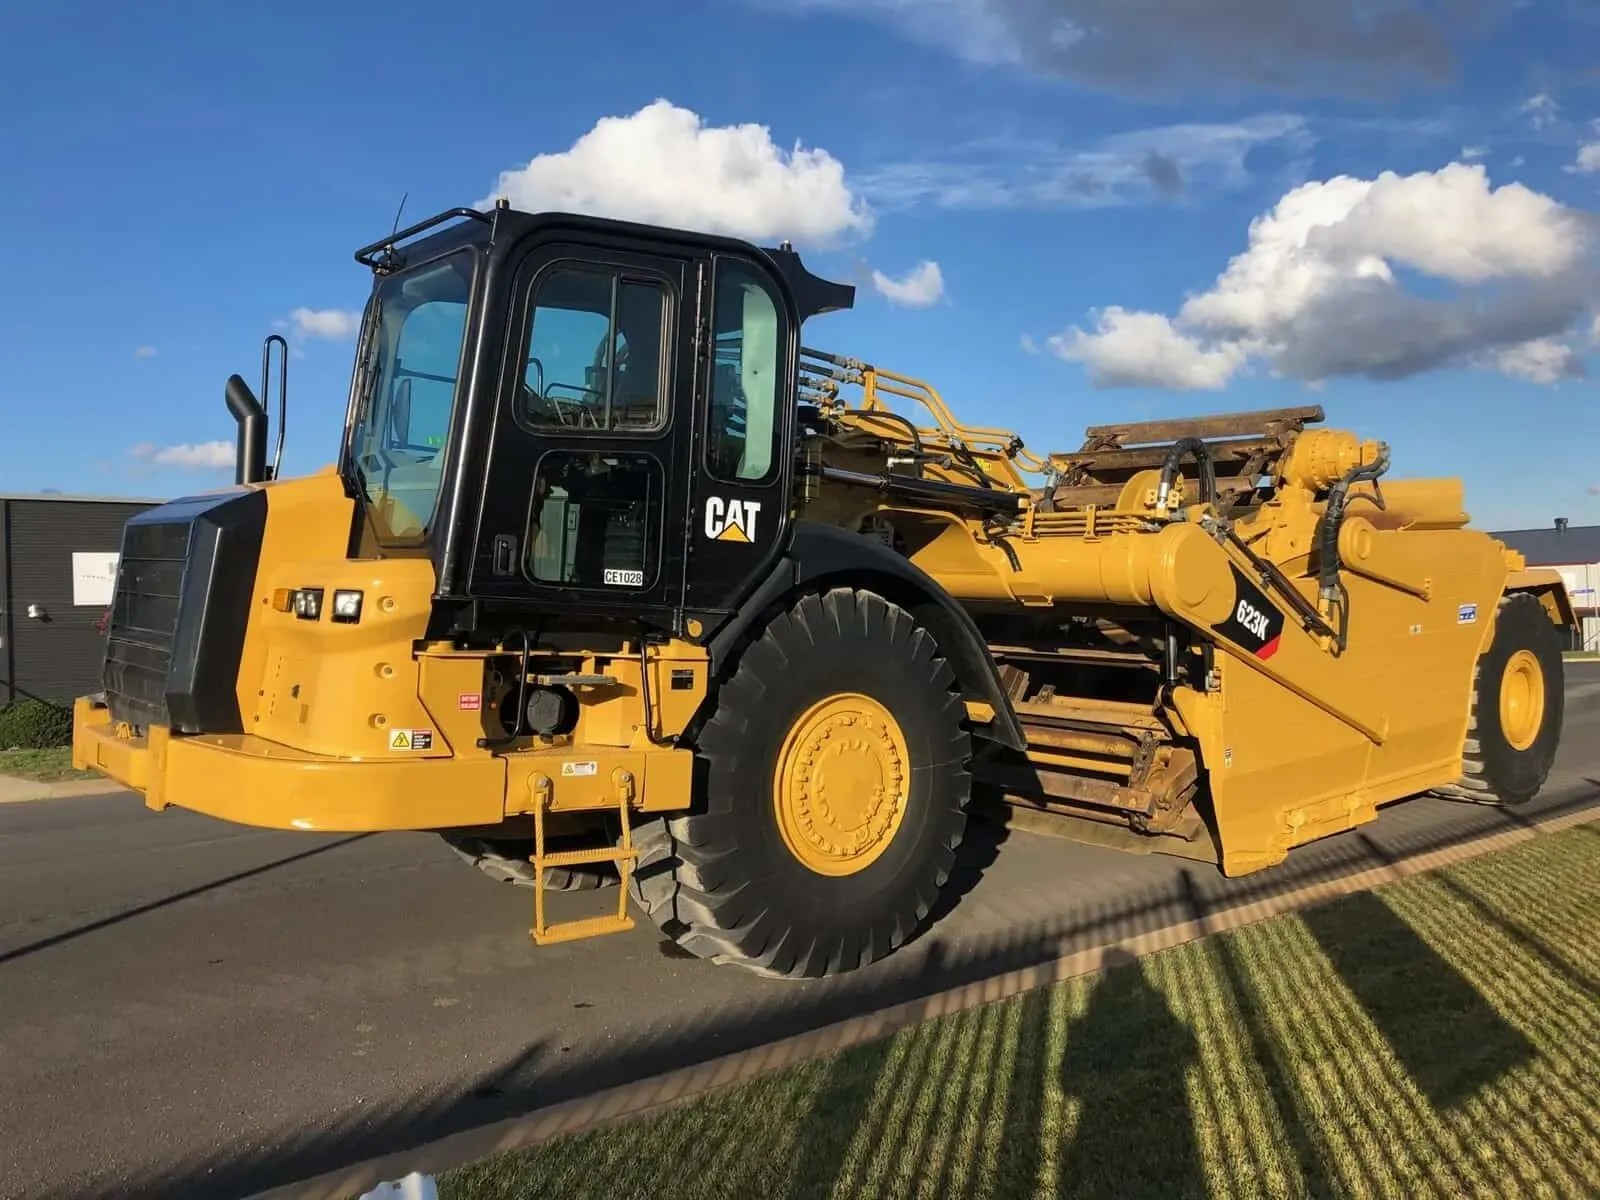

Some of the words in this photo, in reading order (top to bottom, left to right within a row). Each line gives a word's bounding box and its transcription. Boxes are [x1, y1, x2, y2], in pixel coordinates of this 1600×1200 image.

[705, 496, 761, 543] CAT
[605, 570, 642, 584] CE1028
[1237, 600, 1269, 641] 623K
